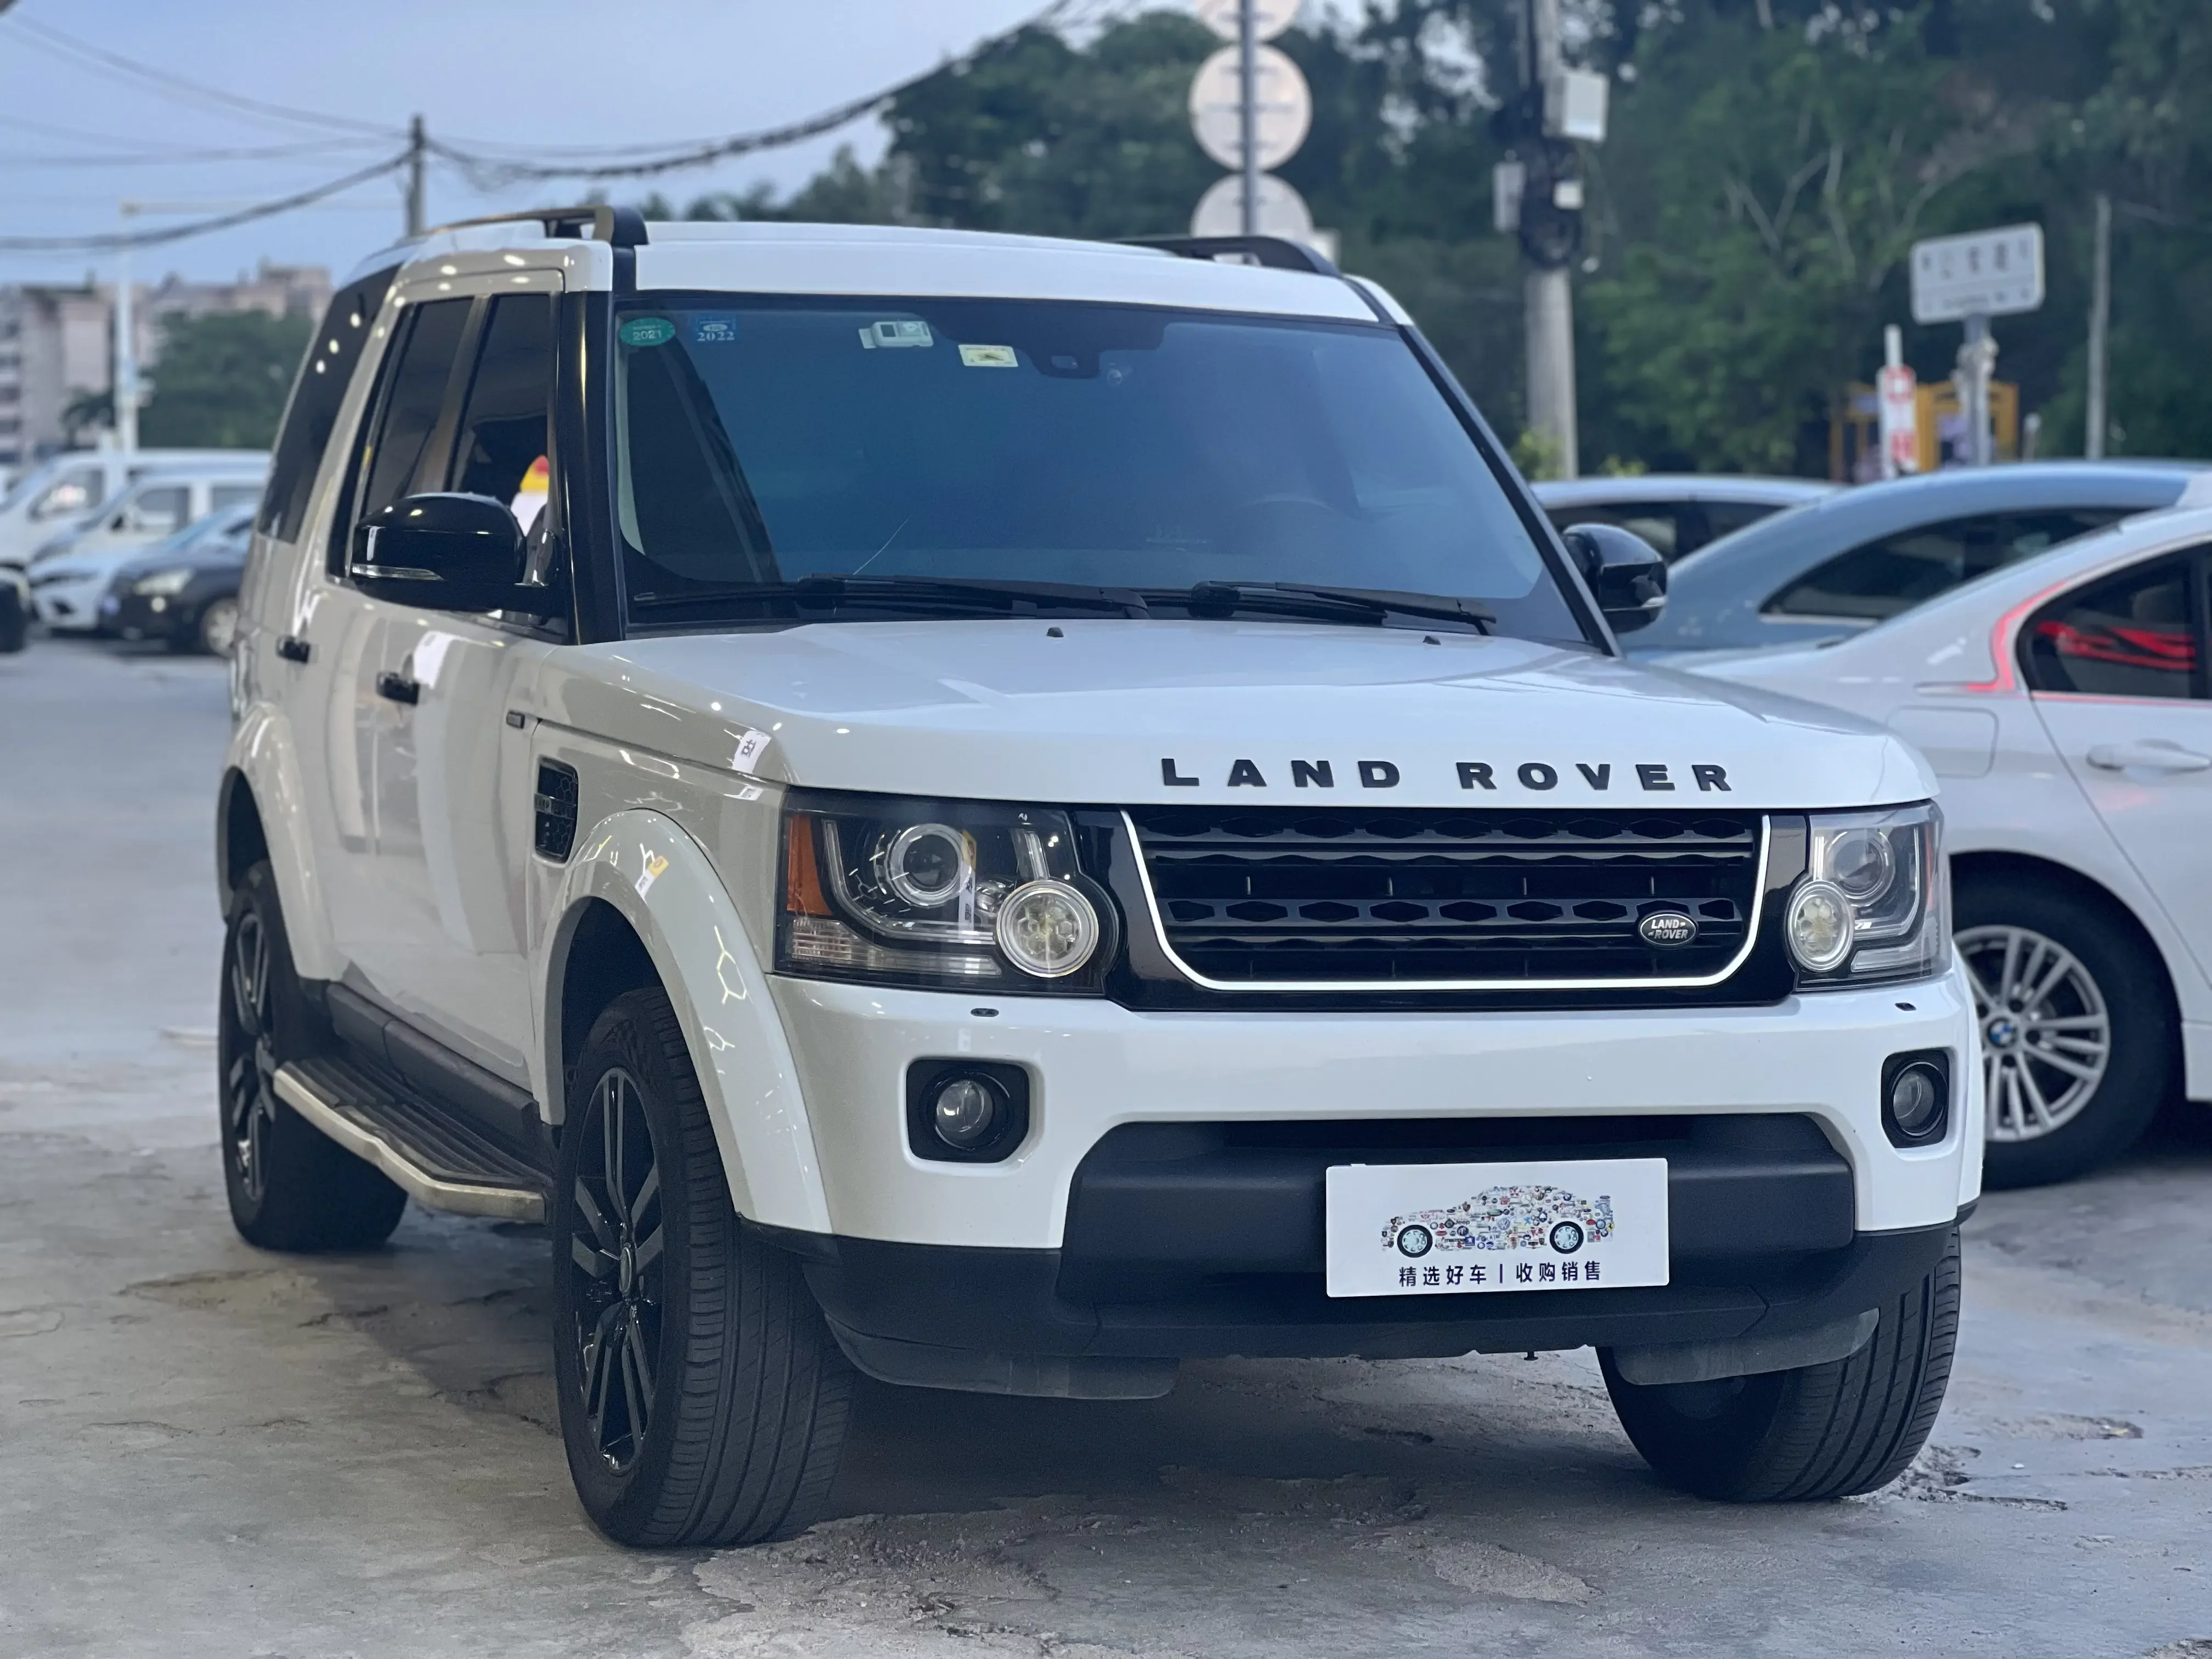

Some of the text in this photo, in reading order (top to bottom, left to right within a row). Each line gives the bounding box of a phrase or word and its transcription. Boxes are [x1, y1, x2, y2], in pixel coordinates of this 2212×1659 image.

[697, 331, 735, 341] 2022
[1161, 758, 1733, 792] LAND ROVER
[1651, 919, 1679, 929] LAND
[1654, 929, 1688, 939] ROVER
[1399, 1260, 1601, 1287] 精选好车 收购销售
